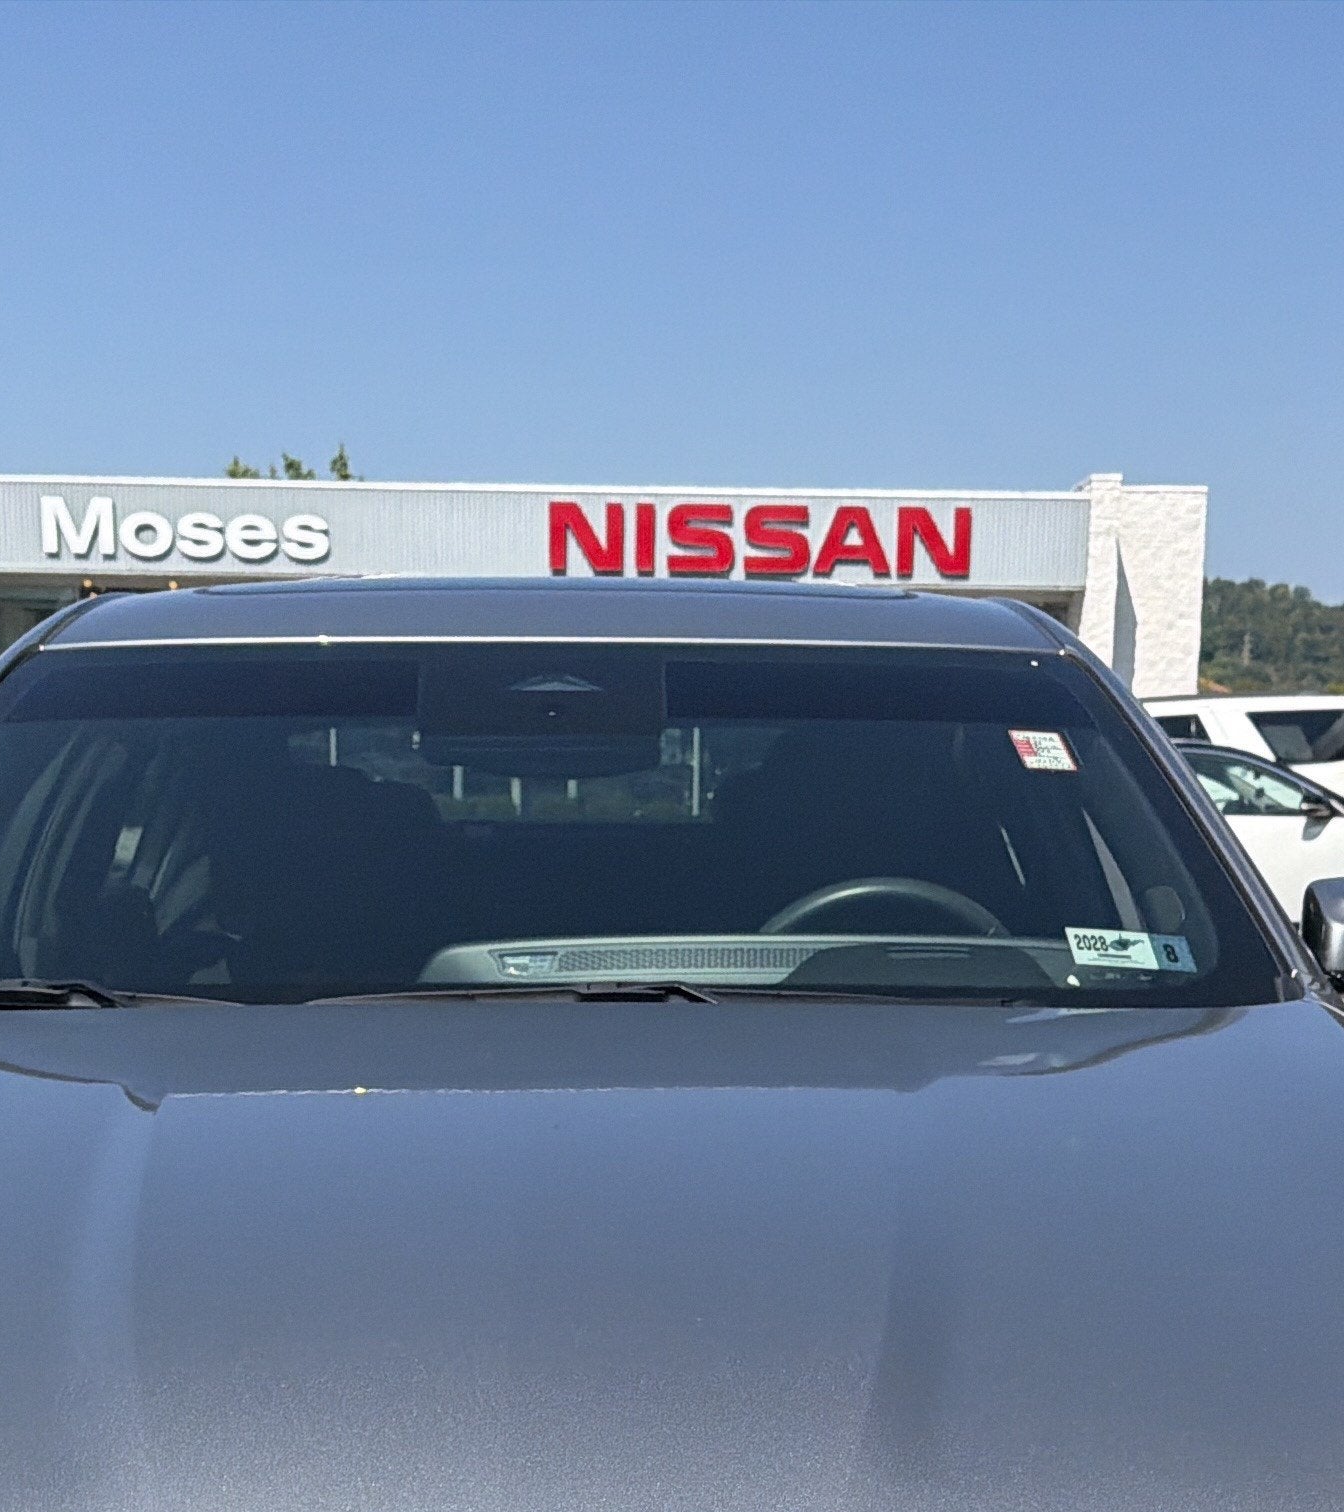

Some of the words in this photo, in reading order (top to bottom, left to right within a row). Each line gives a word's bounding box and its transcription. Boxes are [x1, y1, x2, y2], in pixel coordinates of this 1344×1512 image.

[40, 496, 332, 562] Moses
[549, 502, 972, 577] NISSAN
[1074, 933, 1109, 952] 2028
